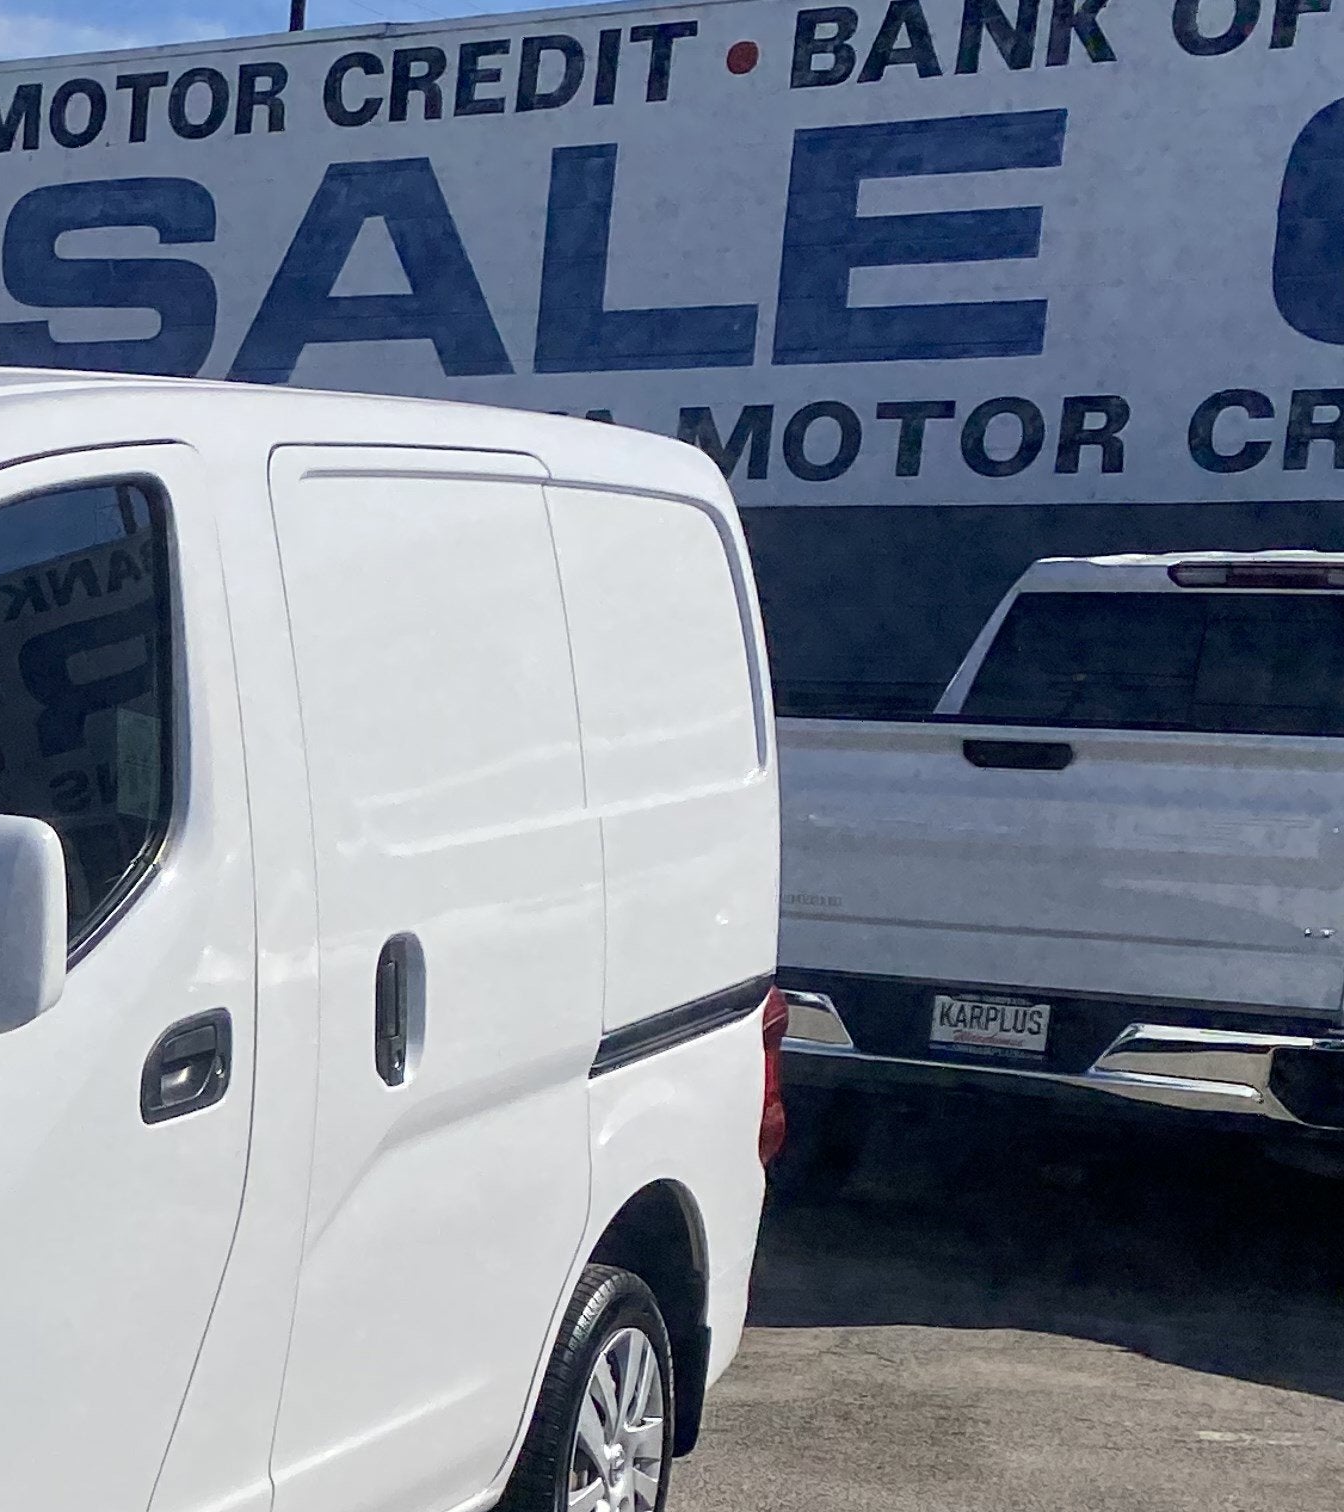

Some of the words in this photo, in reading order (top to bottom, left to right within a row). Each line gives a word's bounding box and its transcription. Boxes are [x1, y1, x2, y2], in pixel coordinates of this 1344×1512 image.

[323, 20, 698, 128] CREDIT
[790, 0, 1118, 89] BANK
[677, 394, 1130, 481] MOTOR
[939, 1002, 1044, 1036] KARPLUS
